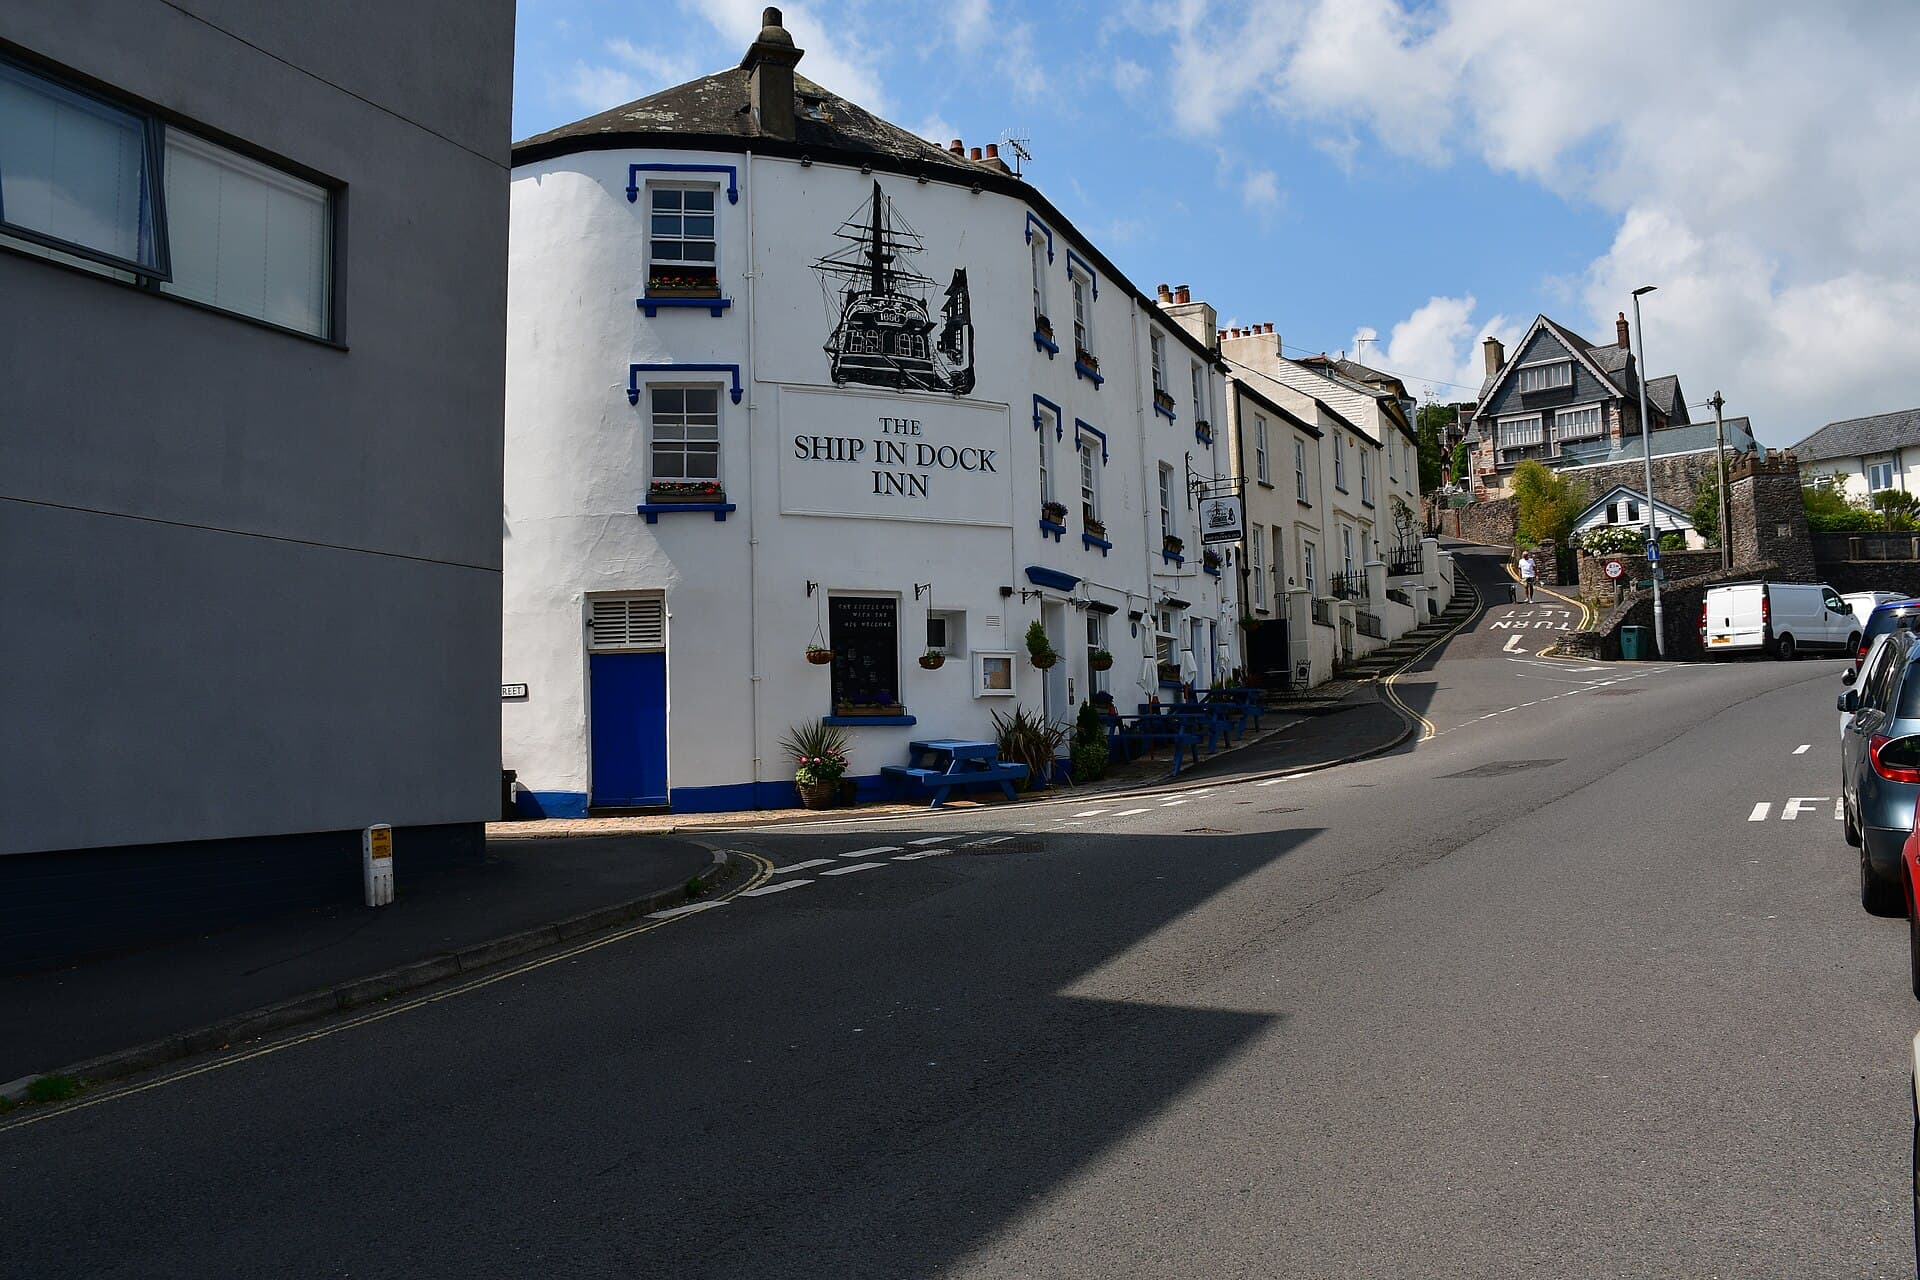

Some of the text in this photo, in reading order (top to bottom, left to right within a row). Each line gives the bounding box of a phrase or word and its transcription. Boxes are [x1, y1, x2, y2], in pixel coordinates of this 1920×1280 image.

[879, 417, 921, 436] THE
[794, 435, 996, 473] SHIP IN DOCK
[872, 470, 929, 497] INN
[1500, 610, 1571, 619] LEFT
[1489, 620, 1571, 631] TURN
[502, 687, 522, 696] REET
